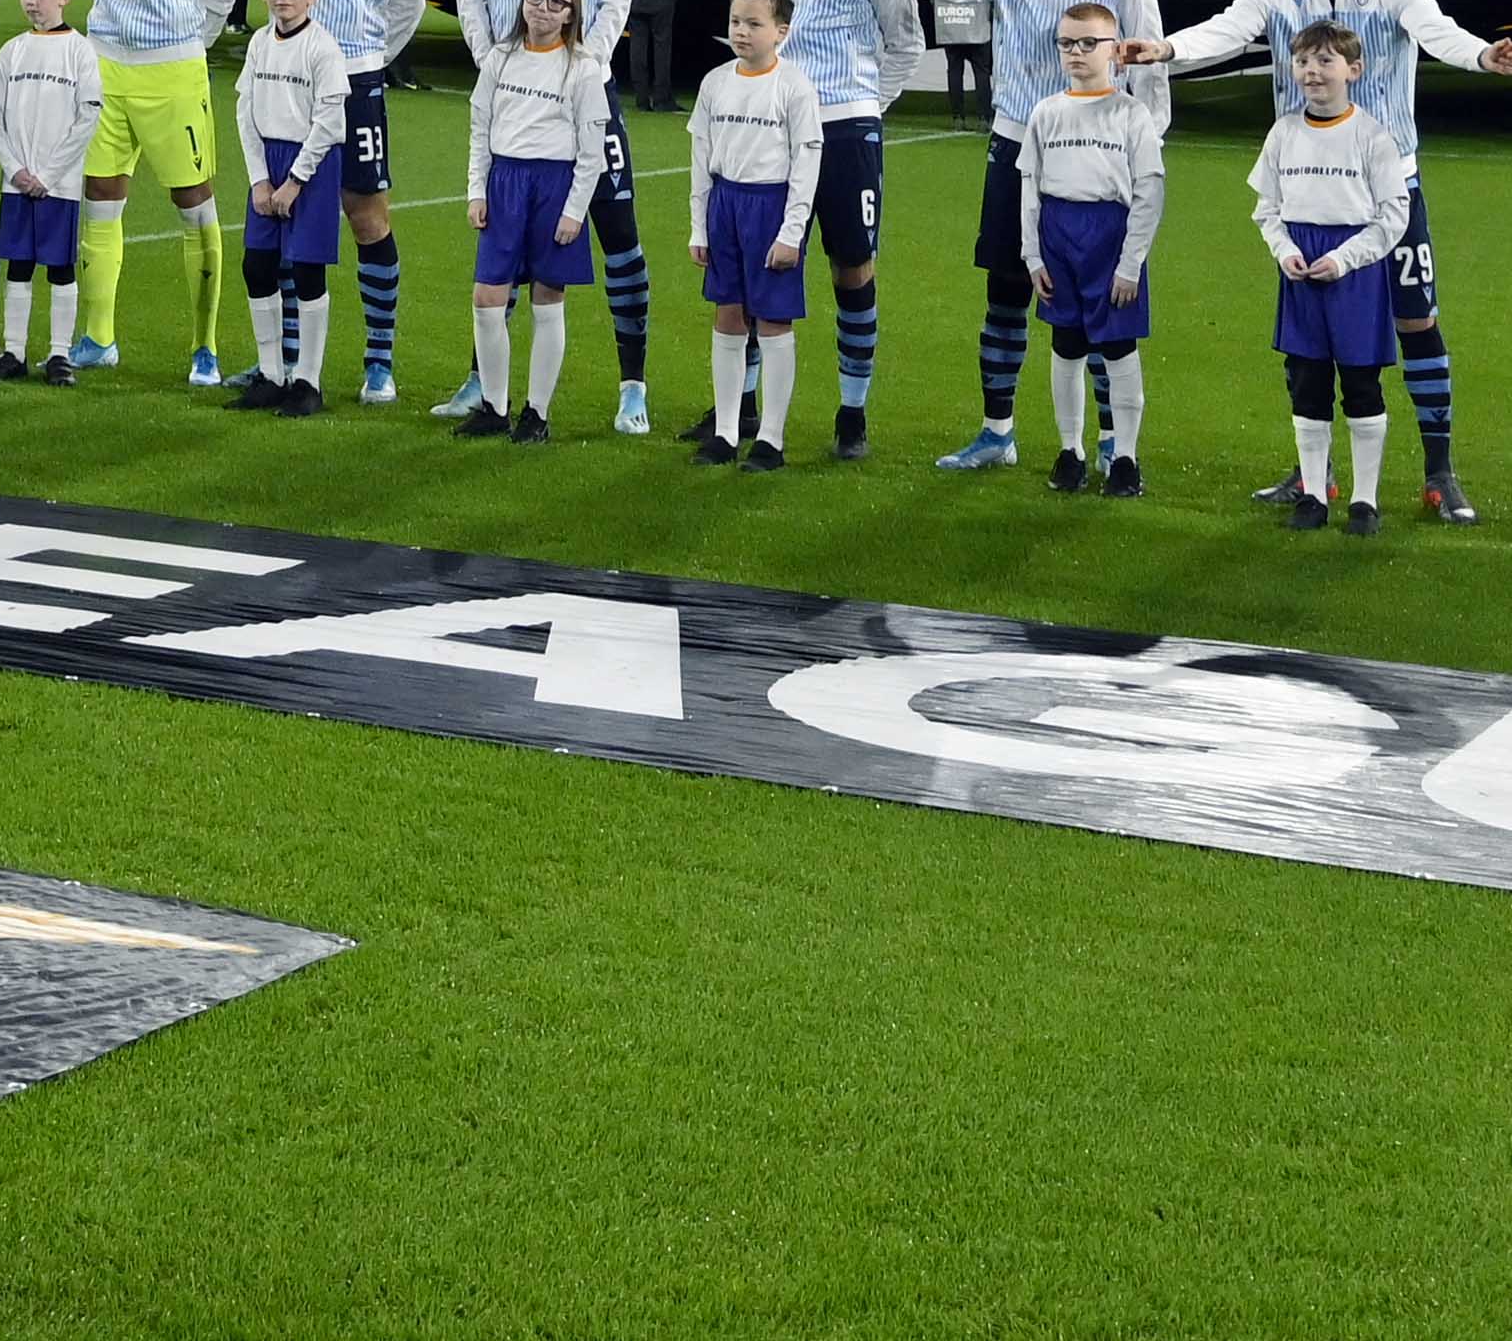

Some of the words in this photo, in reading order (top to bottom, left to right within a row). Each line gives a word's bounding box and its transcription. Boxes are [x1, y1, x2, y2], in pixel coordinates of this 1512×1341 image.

[937, 6, 975, 17] EUROPA
[943, 17, 971, 25] LEAGUE
[185, 125, 198, 156] 1
[355, 126, 384, 163] 33
[860, 188, 875, 227] 6
[1394, 242, 1434, 286] 29
